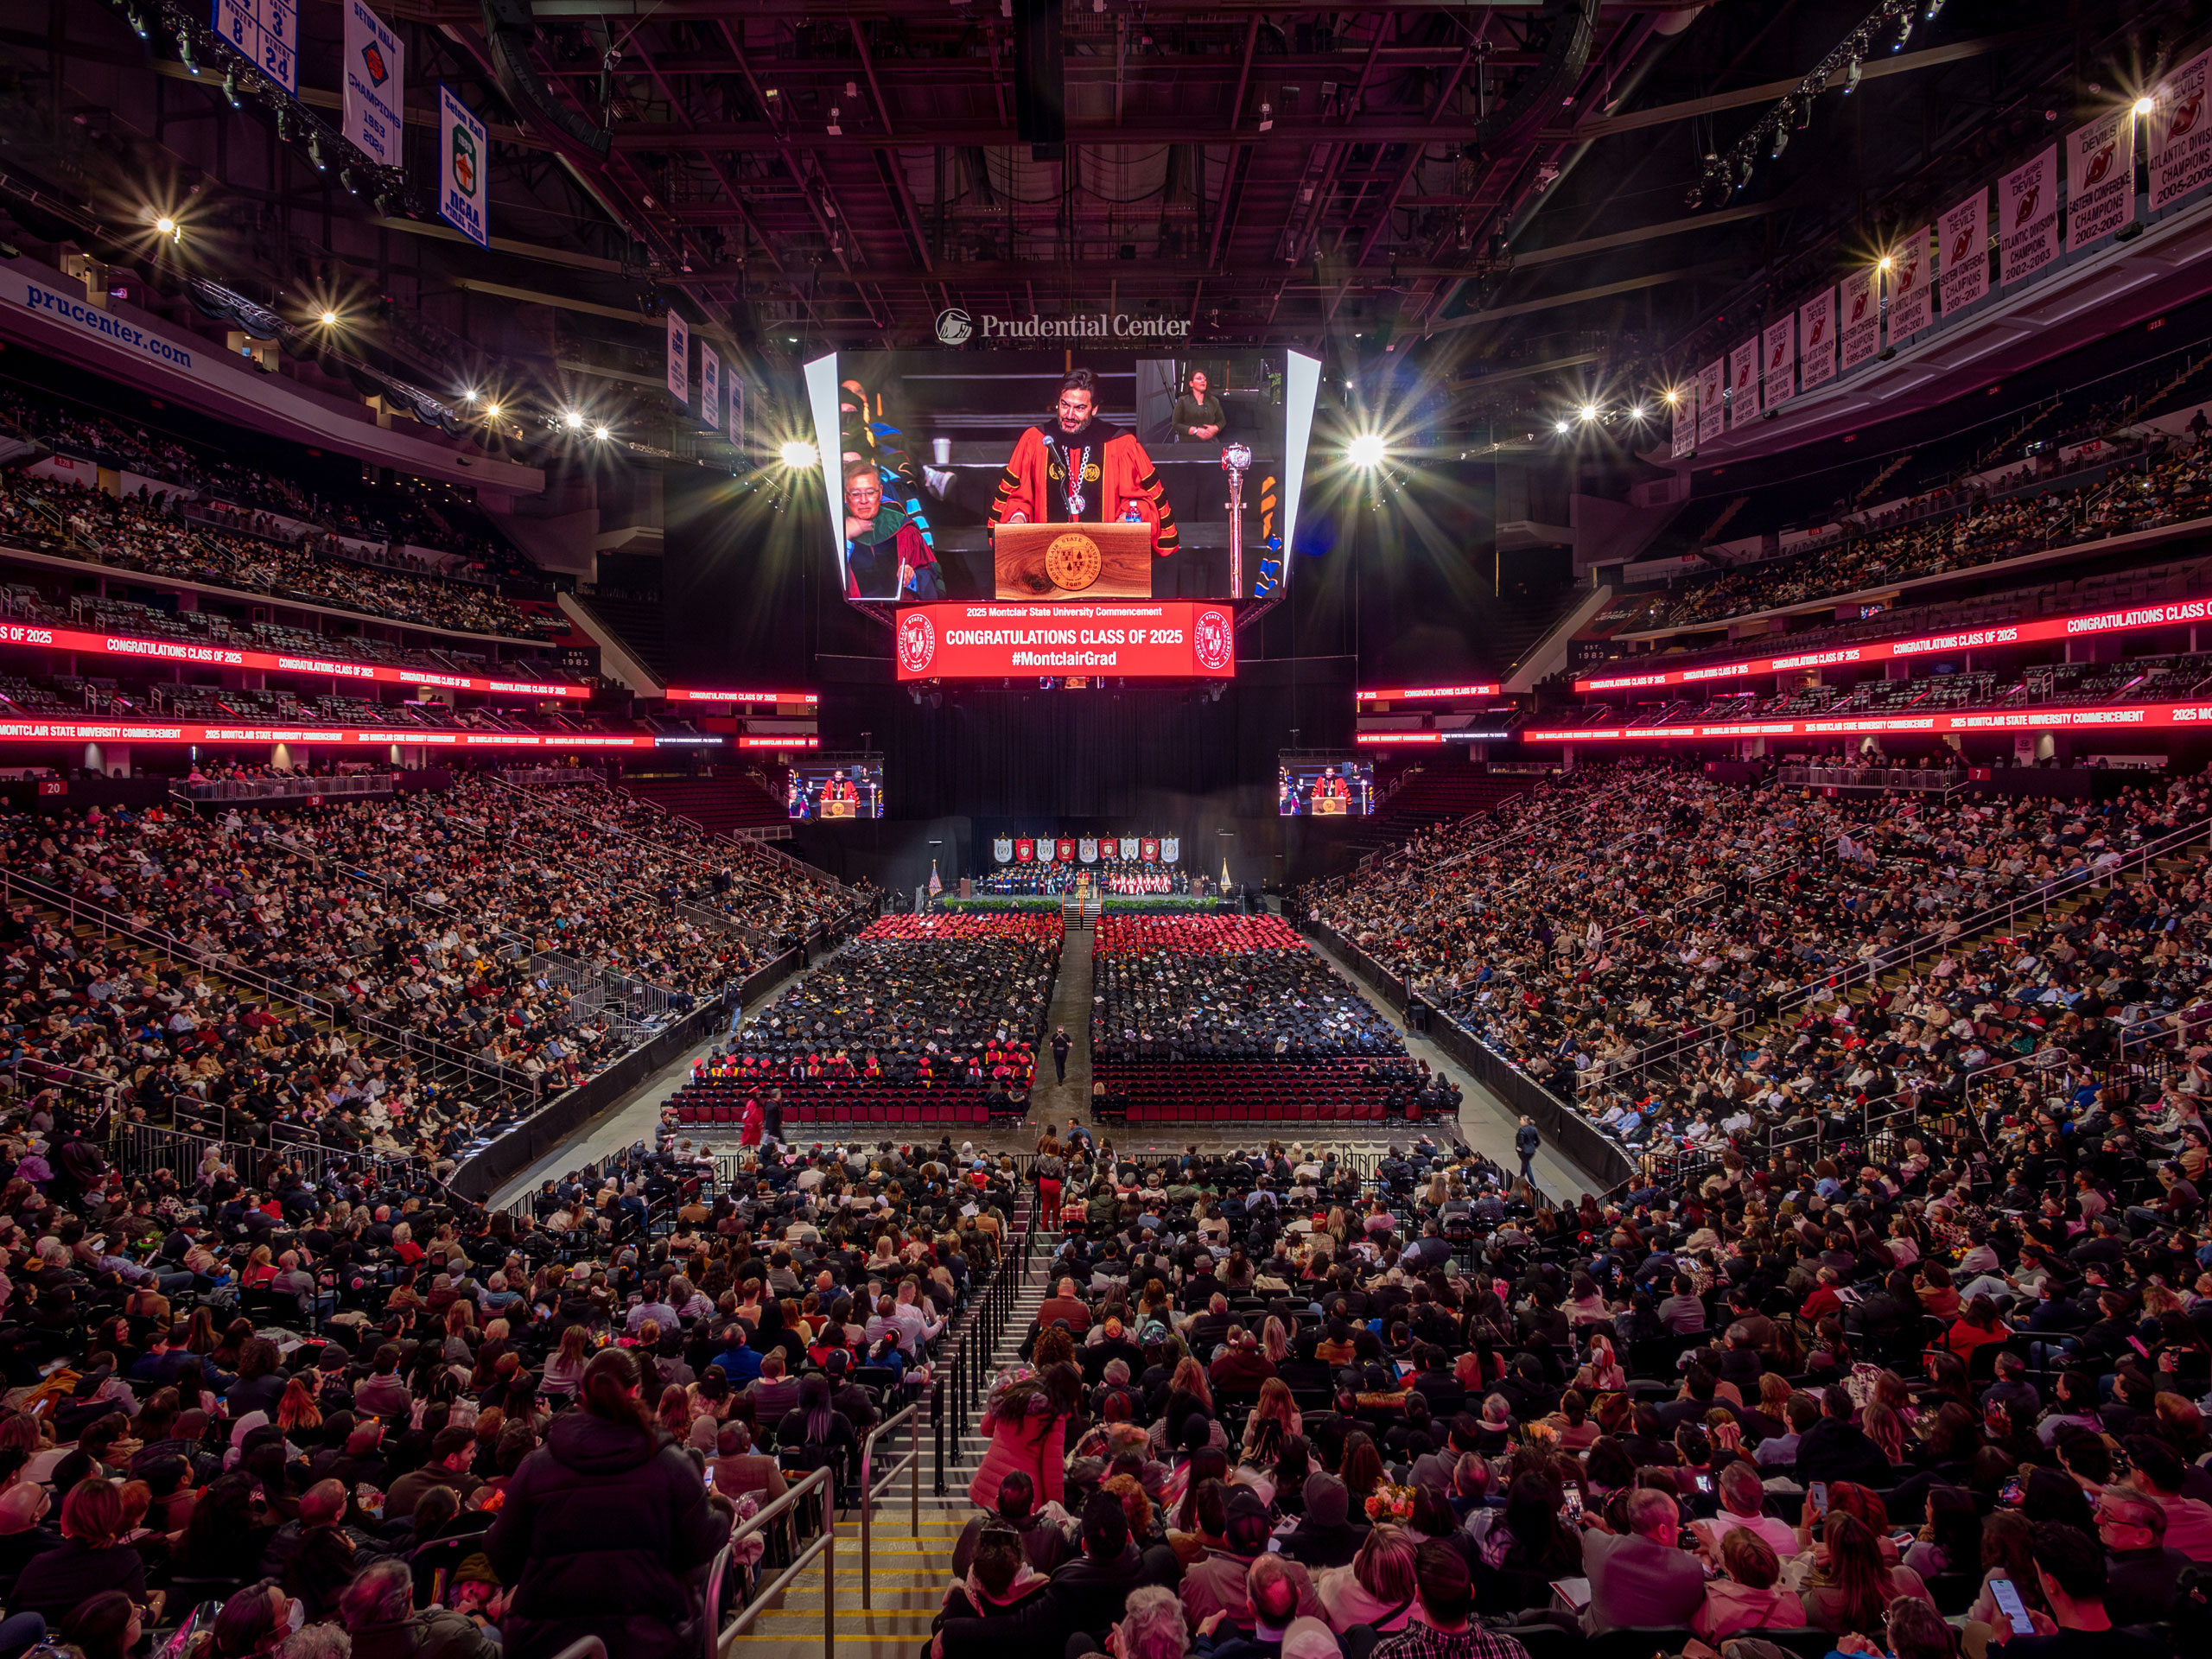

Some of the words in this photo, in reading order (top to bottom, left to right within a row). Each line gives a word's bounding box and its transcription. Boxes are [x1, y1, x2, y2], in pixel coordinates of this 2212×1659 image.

[233, 17, 243, 45] 8
[273, 11, 283, 36] 3
[354, 2, 377, 35] SETON
[378, 25, 396, 54] HALL
[266, 46, 289, 83] 24
[348, 72, 401, 130] CHAMPIONS
[2164, 71, 2205, 105] DEVILS
[364, 110, 385, 139] 1953
[445, 94, 467, 125] Seton
[468, 118, 484, 142] Hall
[363, 128, 385, 157] 2024
[2082, 124, 2117, 154] DEVILS
[2149, 141, 2187, 173] ATLANTIC
[2162, 148, 2211, 185] CHAMPIONS
[2012, 170, 2042, 196] DEVILS
[2069, 192, 2093, 215] EASTERN
[2094, 170, 2131, 204] CONFERENCE
[2157, 164, 2212, 205] 2005-2006
[1949, 210, 1975, 234] DEVILS
[2075, 193, 2124, 229] CHAMPIONS
[2001, 229, 2028, 252] ATLANTIC
[2030, 211, 2056, 238] DIVISION
[2075, 211, 2124, 245] 2002-2003
[2010, 234, 2046, 264] CHAMPIONS
[1940, 268, 1958, 287] EASTERN
[2005, 248, 2051, 280] 2002-2003
[1850, 277, 1870, 296] DEVILS
[1945, 270, 1981, 299] CHAMPIONS
[27, 284, 192, 368] prucenter.com
[981, 314, 1109, 338] Prudential
[1113, 314, 1191, 337] Center
[1048, 543, 1059, 581] MONTCLAIR
[1085, 541, 1098, 580] UNIVERSITY
[966, 607, 987, 617] 2025
[988, 607, 1027, 617] Montclair
[1029, 607, 1051, 617] State
[1052, 607, 1094, 618] University
[1096, 607, 1162, 616] Commencement
[2068, 608, 2164, 632] CONGRATULATIONS
[2166, 603, 2204, 620] CLASS
[10, 627, 24, 640] OF
[27, 629, 52, 643] 2025
[946, 630, 1077, 645] CONGRATULATIONS
[1080, 629, 1125, 645] CLASS
[1128, 629, 1147, 644] OF
[1149, 629, 1183, 644] 2025
[1196, 620, 1205, 659] MONTCLAIR
[1222, 620, 1230, 660] UNIVERSITY
[1894, 636, 1957, 654] CONGRATULATIONS
[1959, 633, 1983, 646] CLASS
[1986, 632, 1995, 643] OF
[1998, 628, 2017, 641] 2025
[107, 639, 186, 658] CONGRATULATIONS
[188, 648, 212, 660] CLASS
[214, 651, 223, 661] OF
[225, 652, 242, 664] 2025
[1012, 651, 1116, 666] #MontclairGrad
[1772, 655, 1818, 670] CONGRATULATIONS
[1819, 652, 1836, 664] CLASS
[1837, 652, 1844, 661] OF
[1846, 650, 1859, 660] 2025
[279, 658, 334, 673] CONGRATULATIONS
[335, 664, 353, 675] CLASS
[361, 668, 373, 677] 2025
[1951, 718, 1966, 728] 2025
[1967, 716, 2005, 727] MONTCLAIR
[2006, 715, 2027, 726] STATE
[2029, 714, 2071, 725] UNIVERSITY
[2073, 711, 2145, 723] COMMENCEMENT
[2173, 709, 2196, 721] 2025
[51, 726, 75, 737] STATE
[77, 727, 121, 737] UNIVERSITY
[123, 728, 181, 739] COMMENCEMENT
[206, 730, 219, 739] 2025
[48, 783, 60, 794] 20
[1976, 770, 1981, 779] 7
